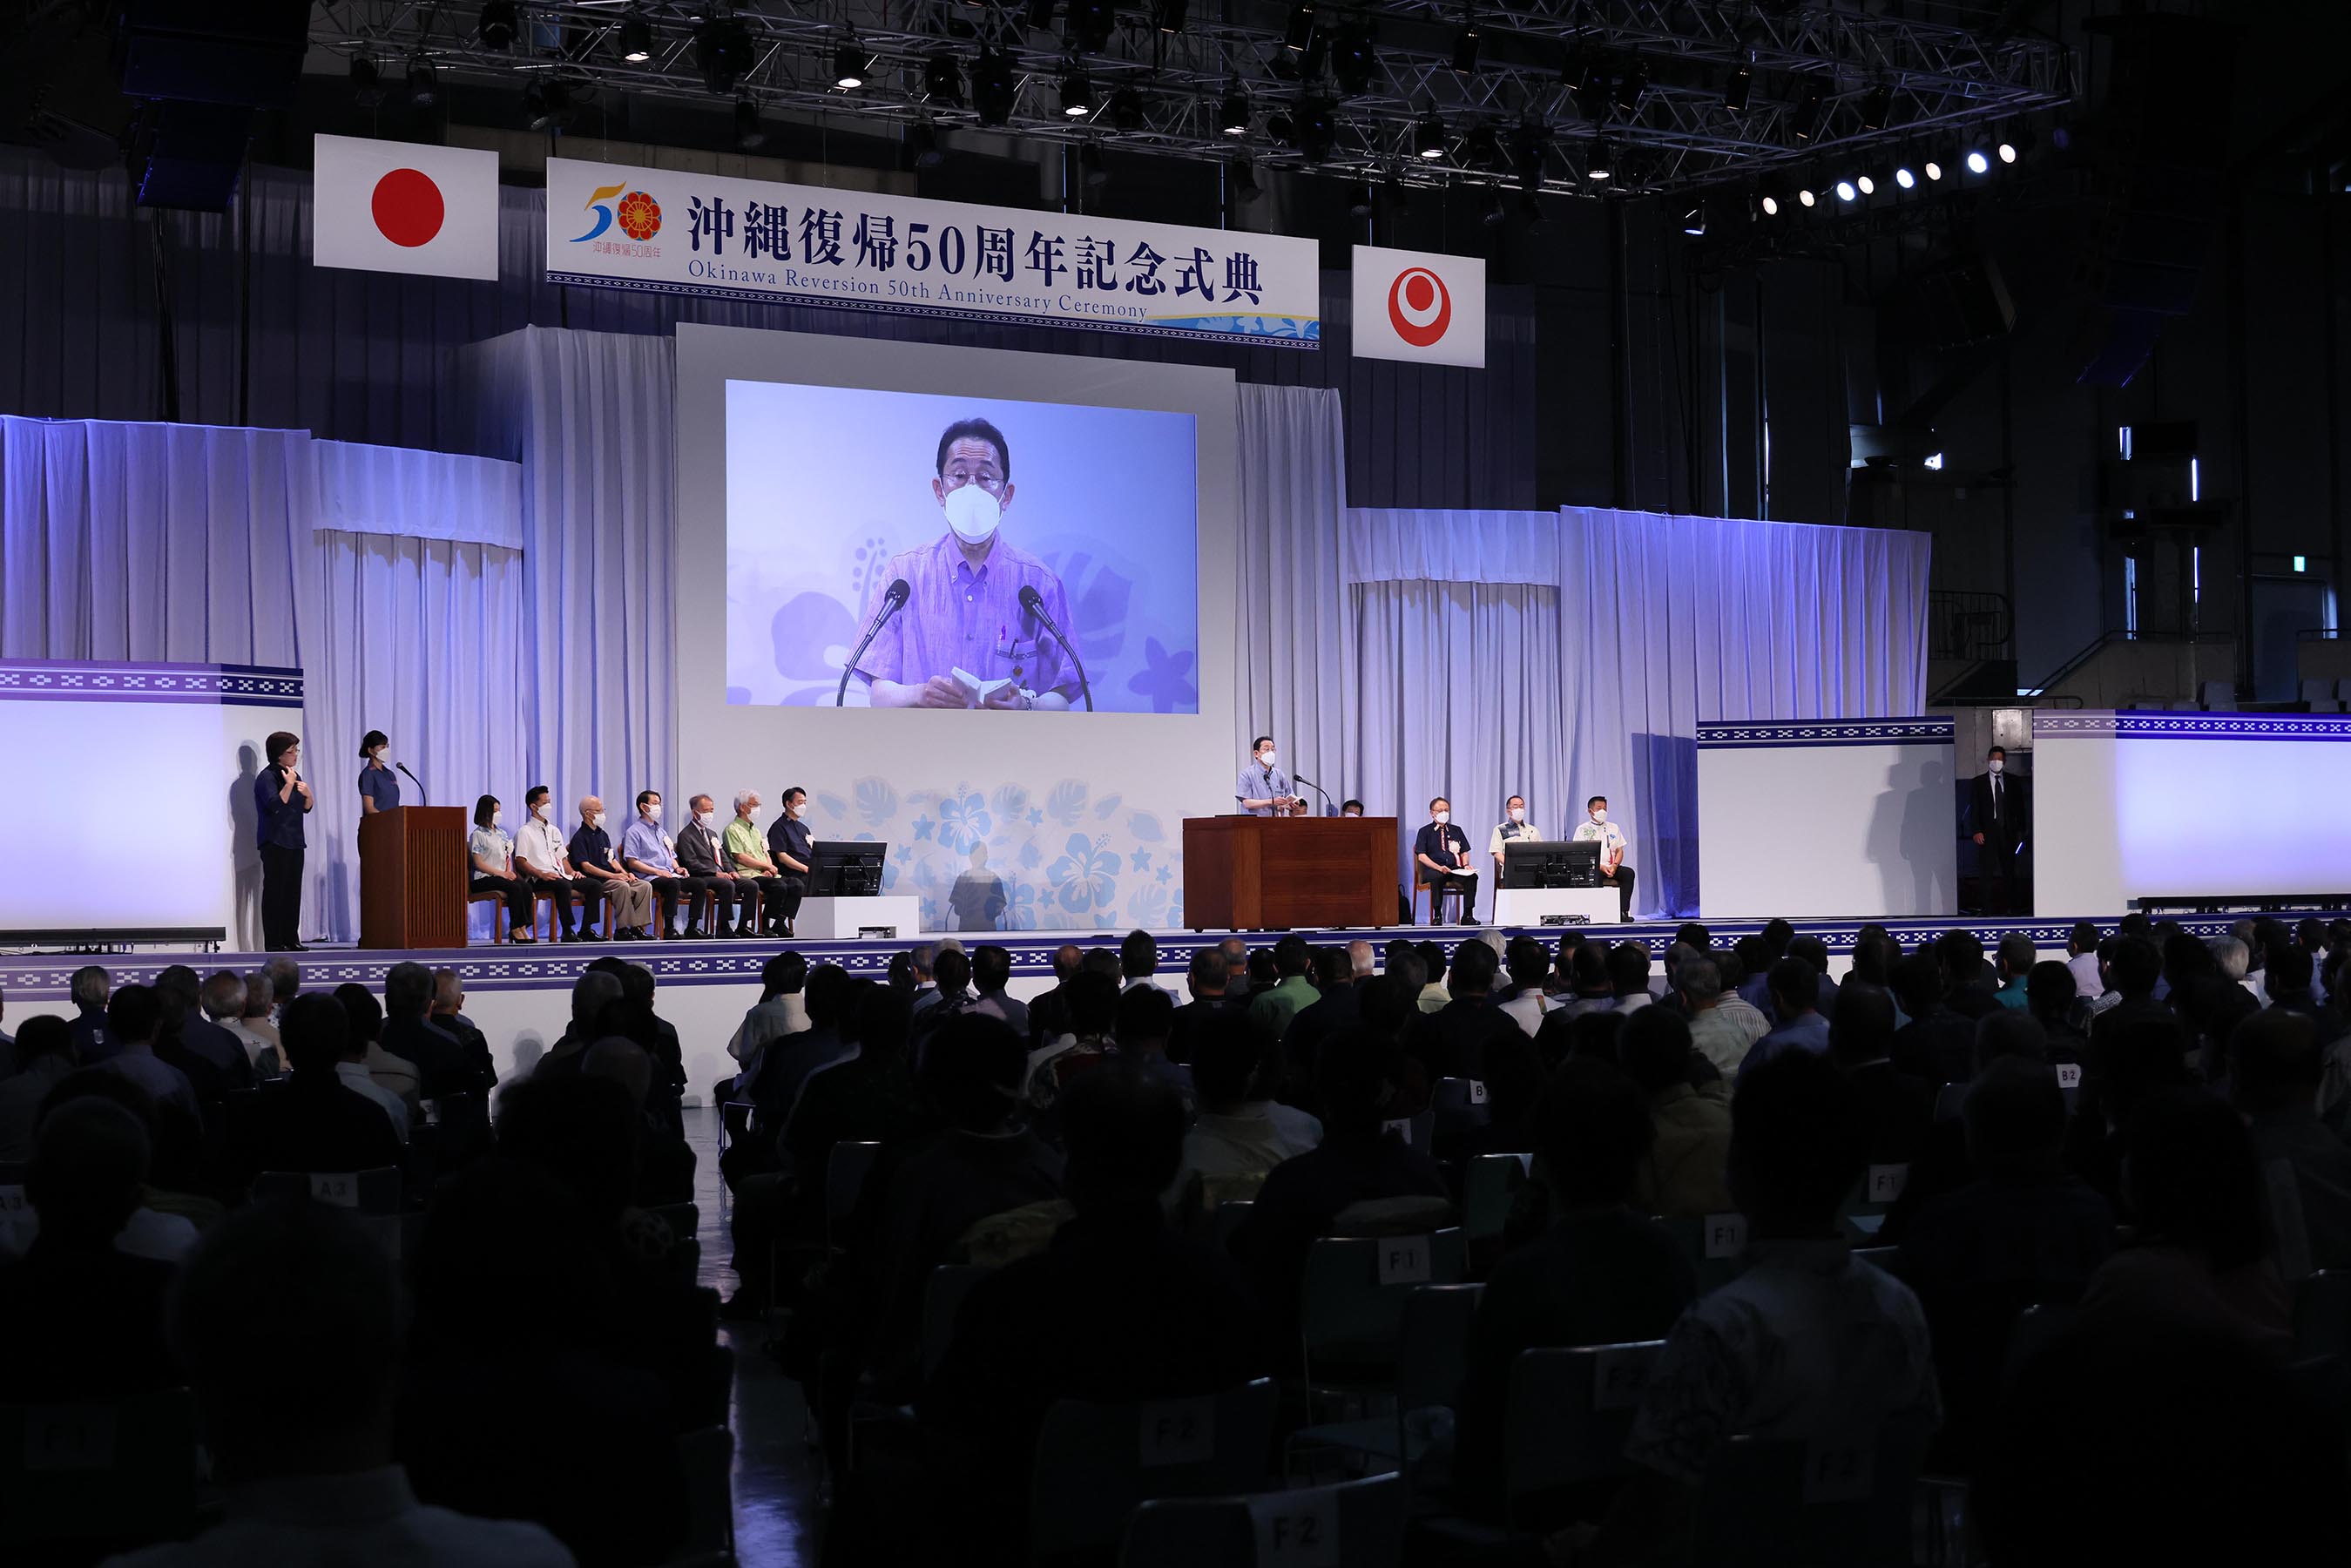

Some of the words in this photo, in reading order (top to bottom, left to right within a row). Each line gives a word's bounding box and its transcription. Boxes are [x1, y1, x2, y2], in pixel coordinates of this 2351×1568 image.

[686, 195, 1263, 306] 沖縄復帰50周年記念式典
[688, 259, 776, 285] Okinawa
[786, 268, 879, 294] Reversion
[888, 280, 929, 299] 50th
[938, 284, 1051, 314] Anniversary
[1058, 294, 1148, 323] Ceremony
